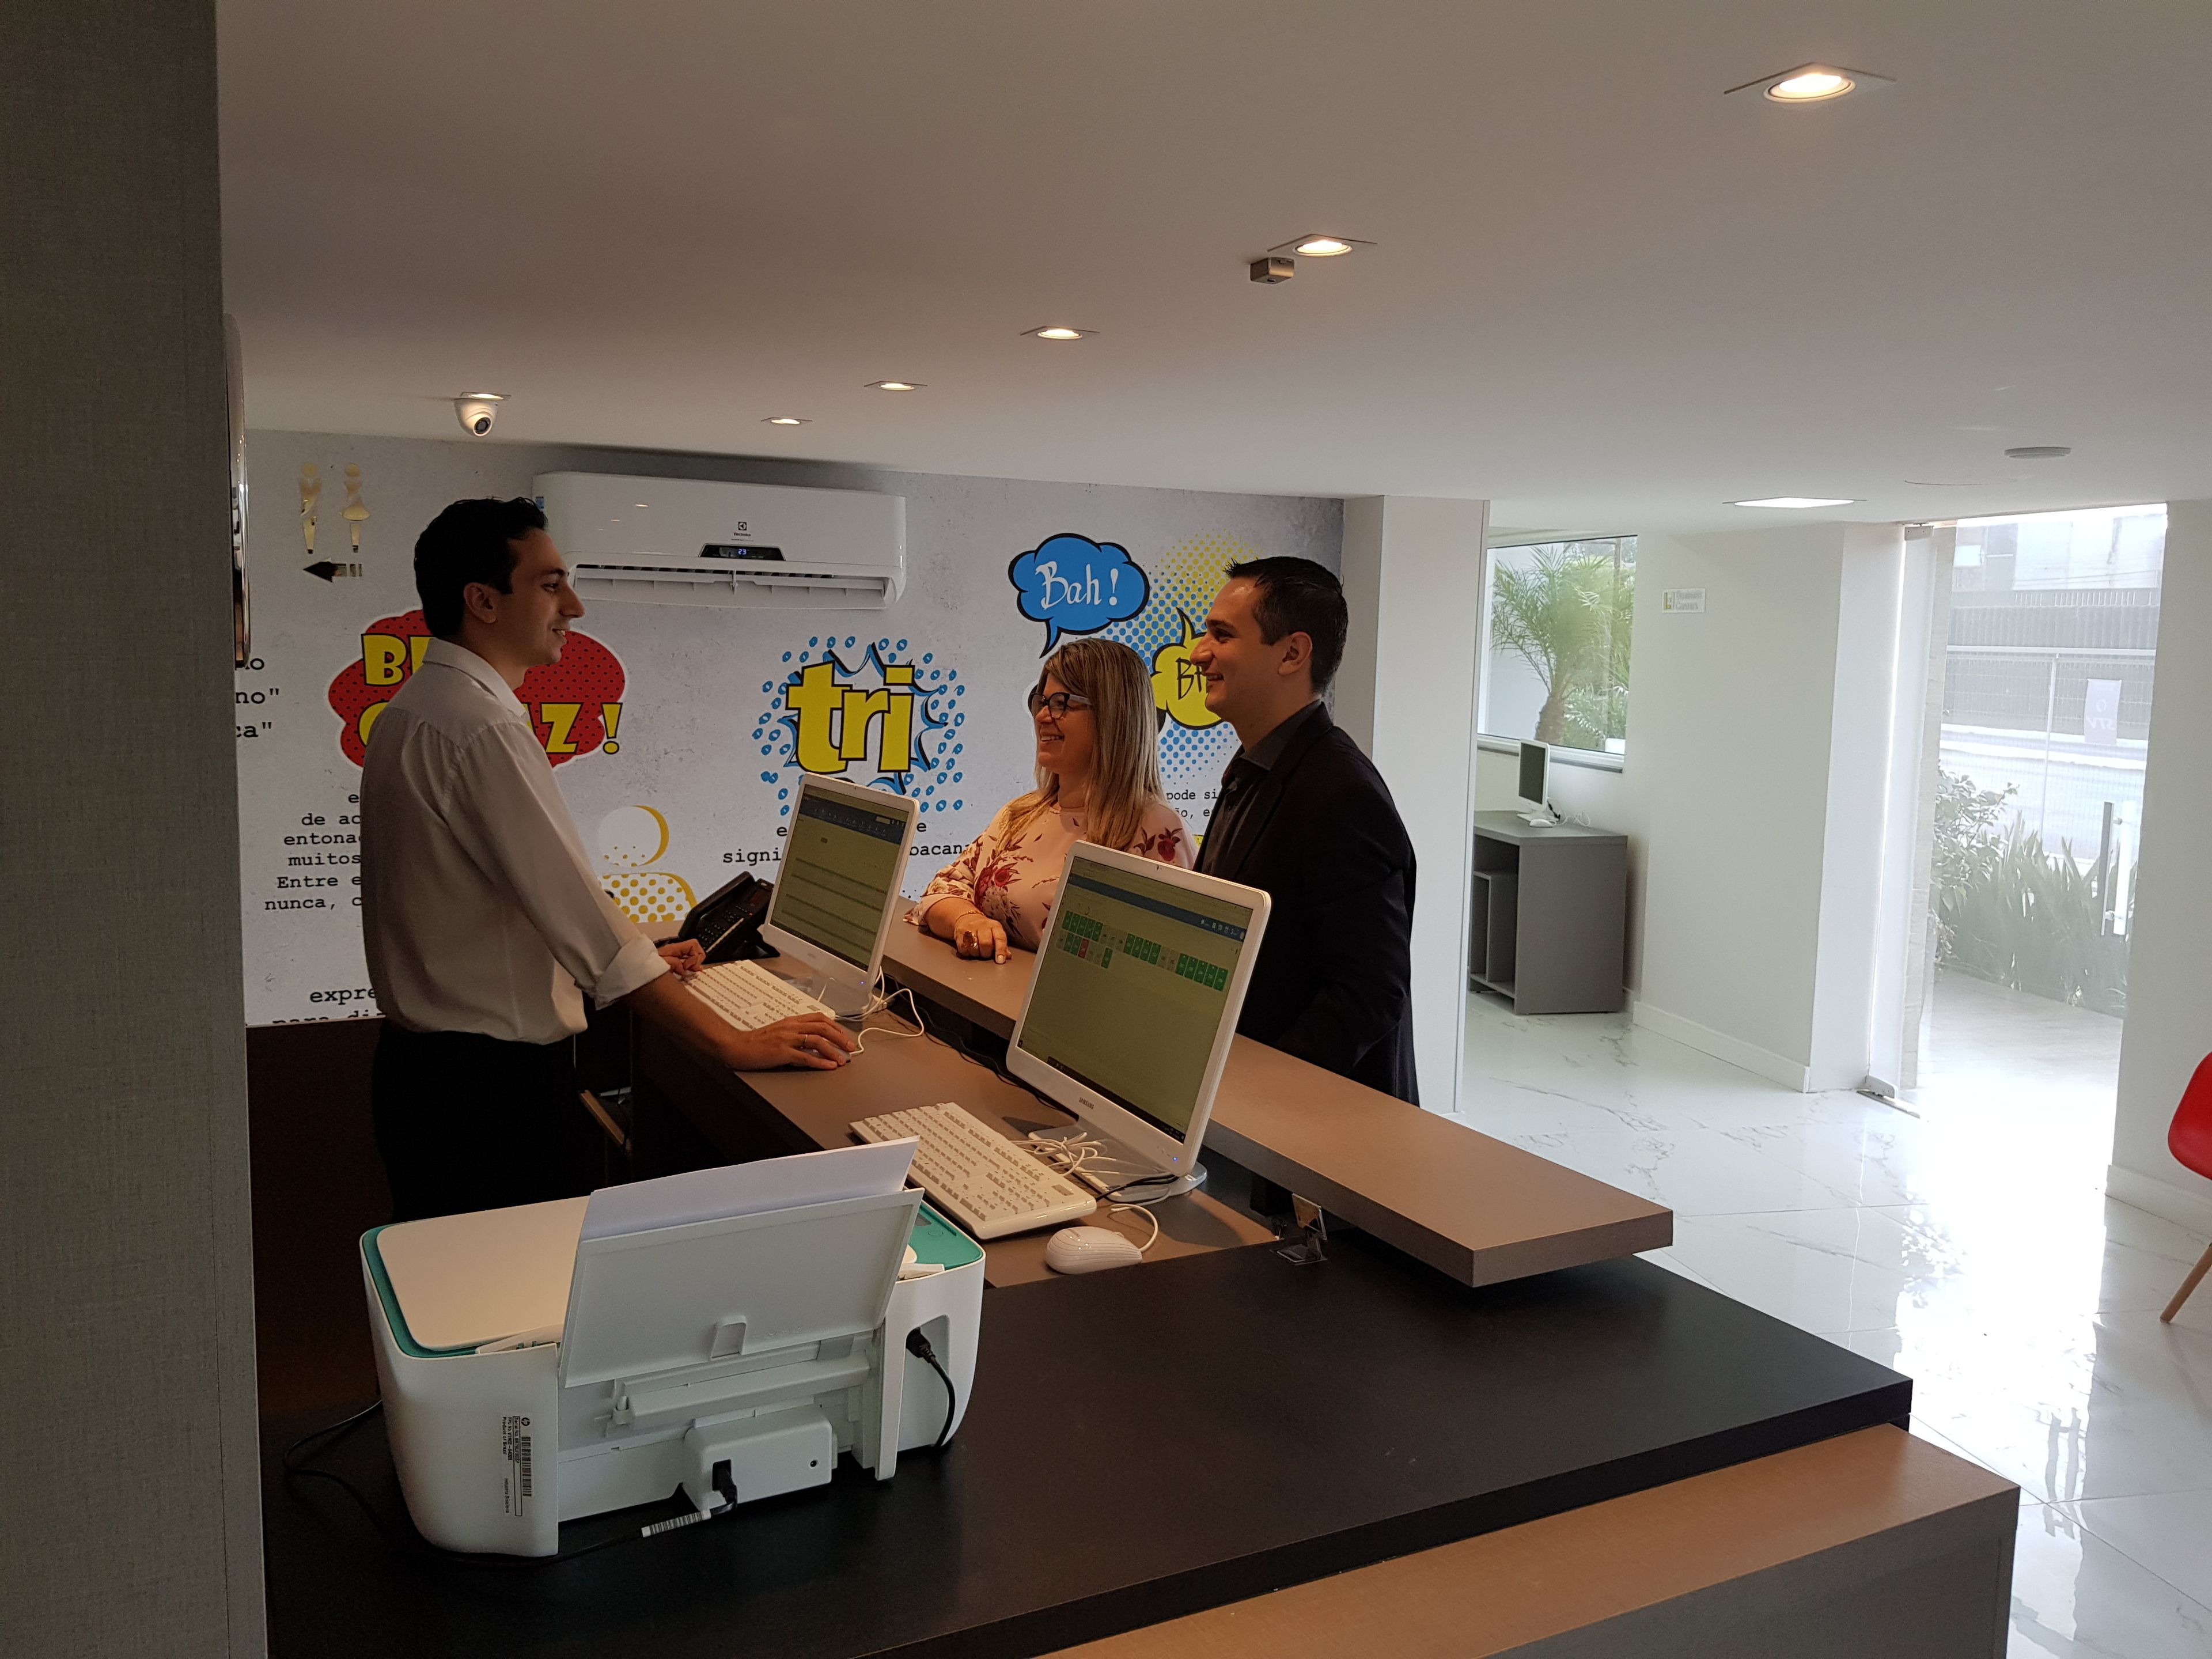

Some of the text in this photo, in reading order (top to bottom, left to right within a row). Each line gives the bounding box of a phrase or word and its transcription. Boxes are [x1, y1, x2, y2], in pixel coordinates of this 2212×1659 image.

[1035, 561, 1119, 609] Bah!
[785, 660, 915, 774] tri
[1166, 789, 1196, 802] pode
[301, 813, 325, 825] de
[284, 833, 361, 845] entona
[289, 853, 361, 866] muitos
[276, 876, 338, 888] Entre
[264, 898, 335, 910] nunca,
